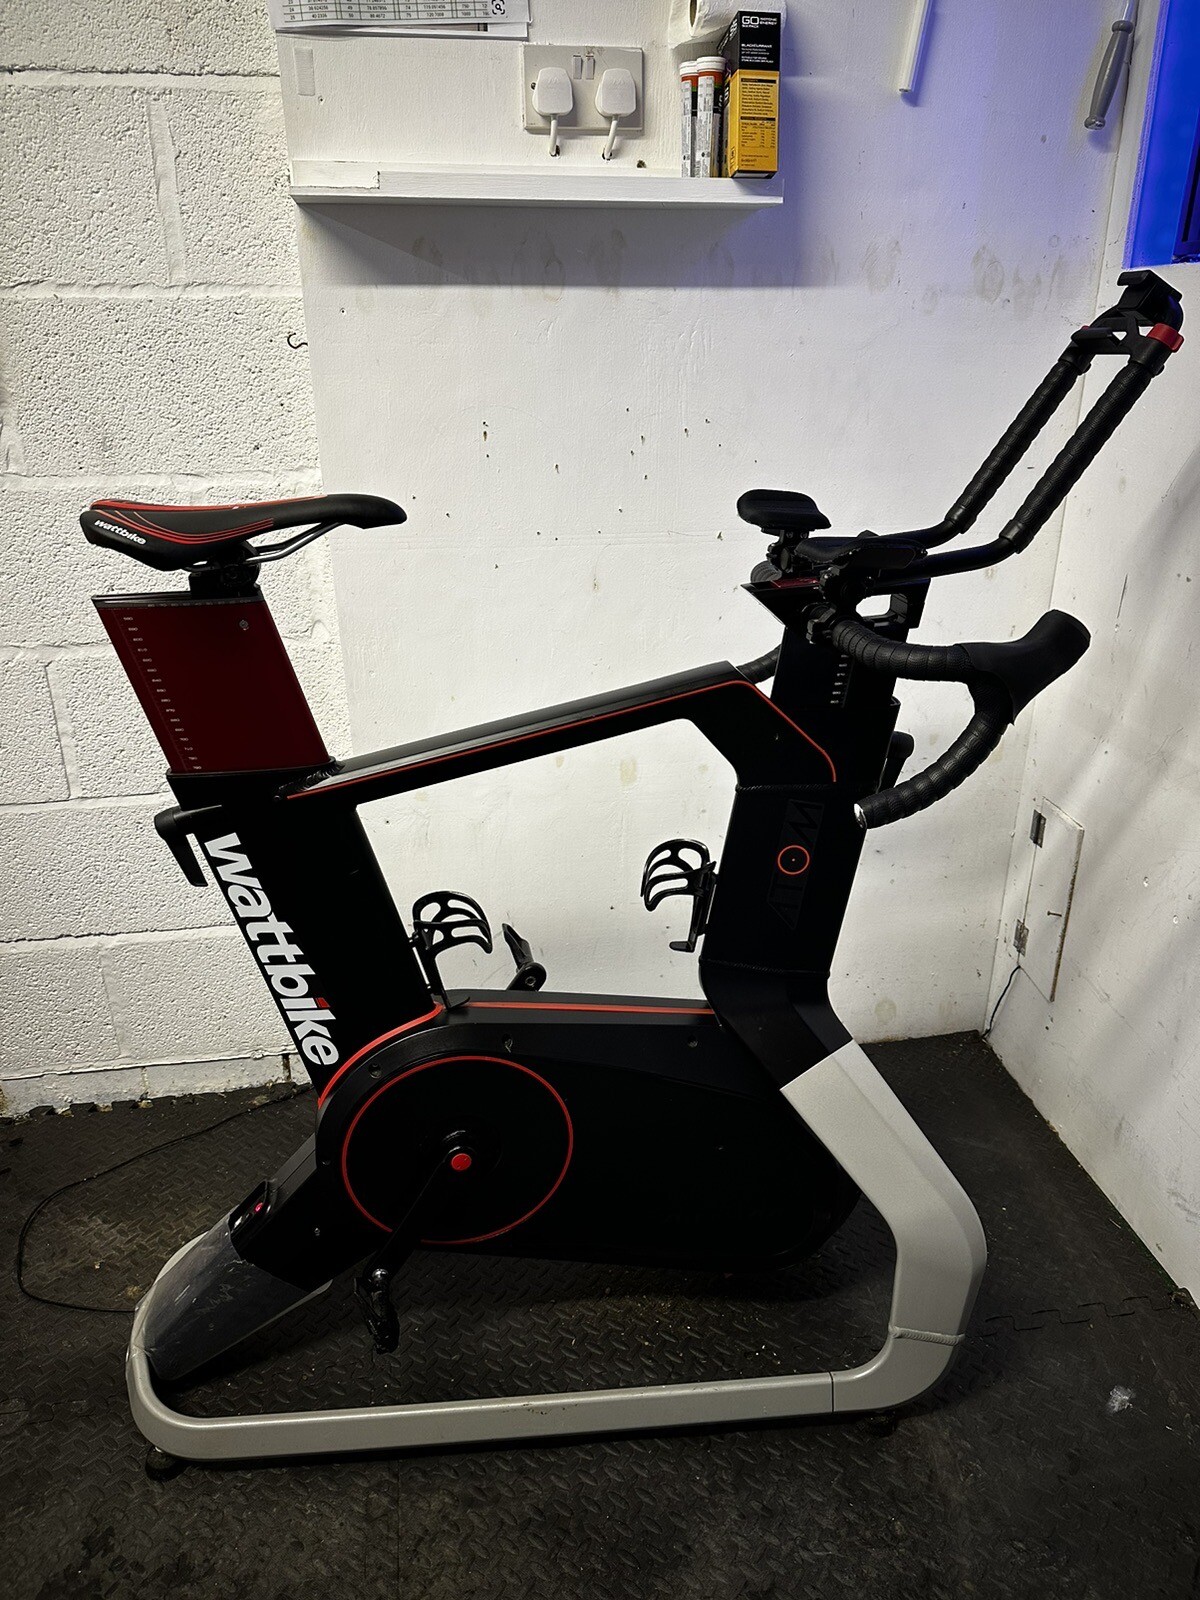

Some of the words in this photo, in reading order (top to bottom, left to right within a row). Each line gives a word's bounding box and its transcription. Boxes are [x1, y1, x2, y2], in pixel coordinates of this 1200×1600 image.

[742, 15, 760, 25] GO
[94, 520, 147, 545] wattbike
[204, 832, 336, 1066] wattbike
